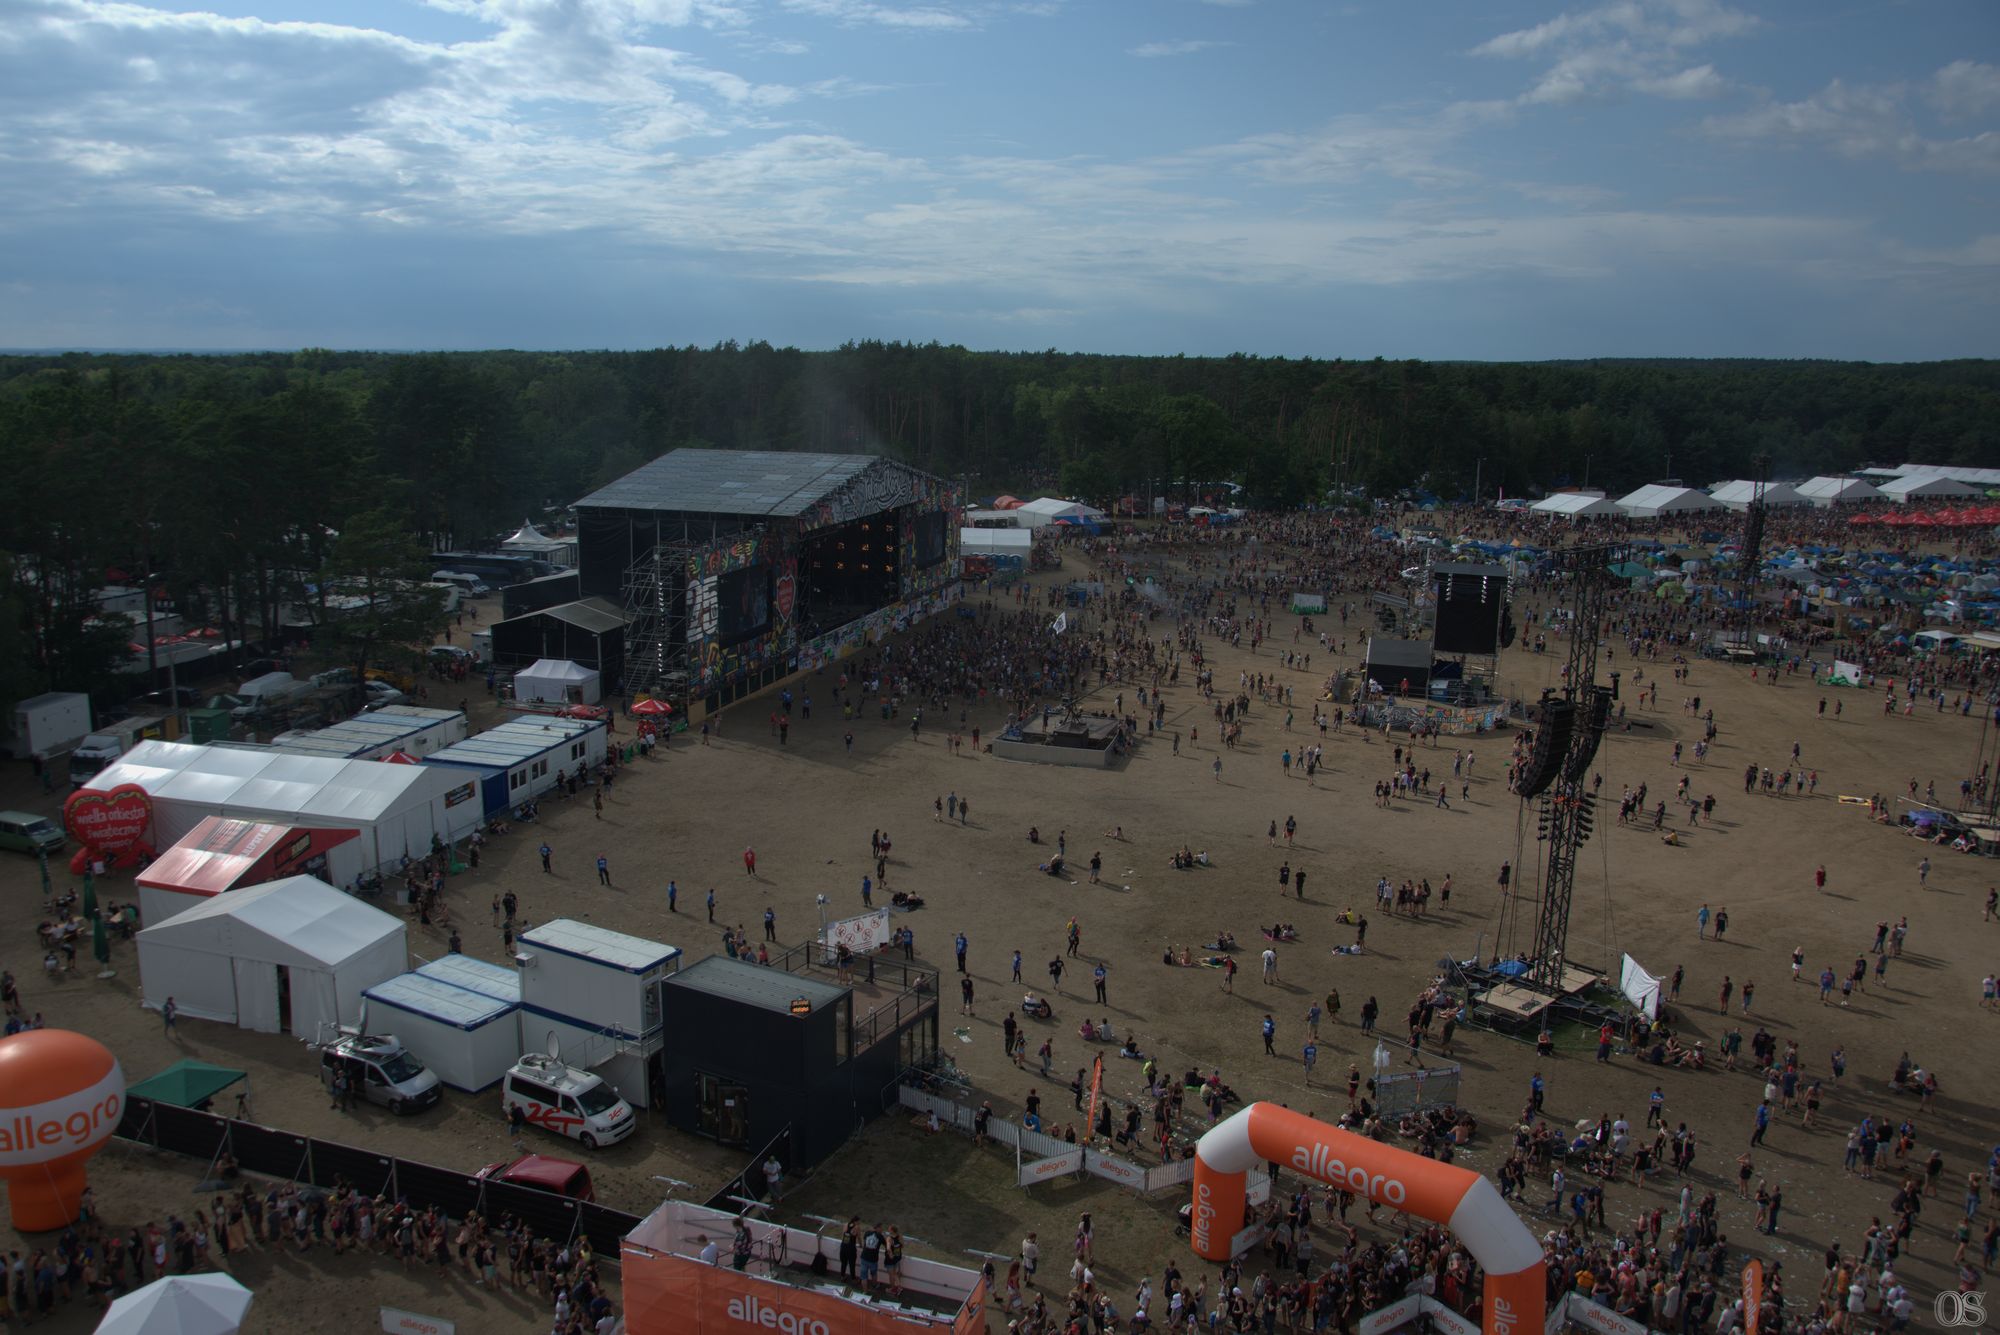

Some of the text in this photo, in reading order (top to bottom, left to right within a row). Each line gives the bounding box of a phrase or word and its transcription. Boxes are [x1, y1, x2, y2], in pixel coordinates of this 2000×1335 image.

[0, 1094, 119, 1152] allegro
[1035, 1160, 1068, 1176] allegro
[1099, 1159, 1131, 1178] allegro
[1291, 1142, 1406, 1204] allegro
[1193, 1183, 1216, 1252] allegro
[400, 1318, 438, 1335] allegro
[727, 1295, 830, 1335] allegro
[1374, 1306, 1406, 1328] allegro
[1432, 1308, 1465, 1335] allegro
[1586, 1308, 1627, 1334] allegro
